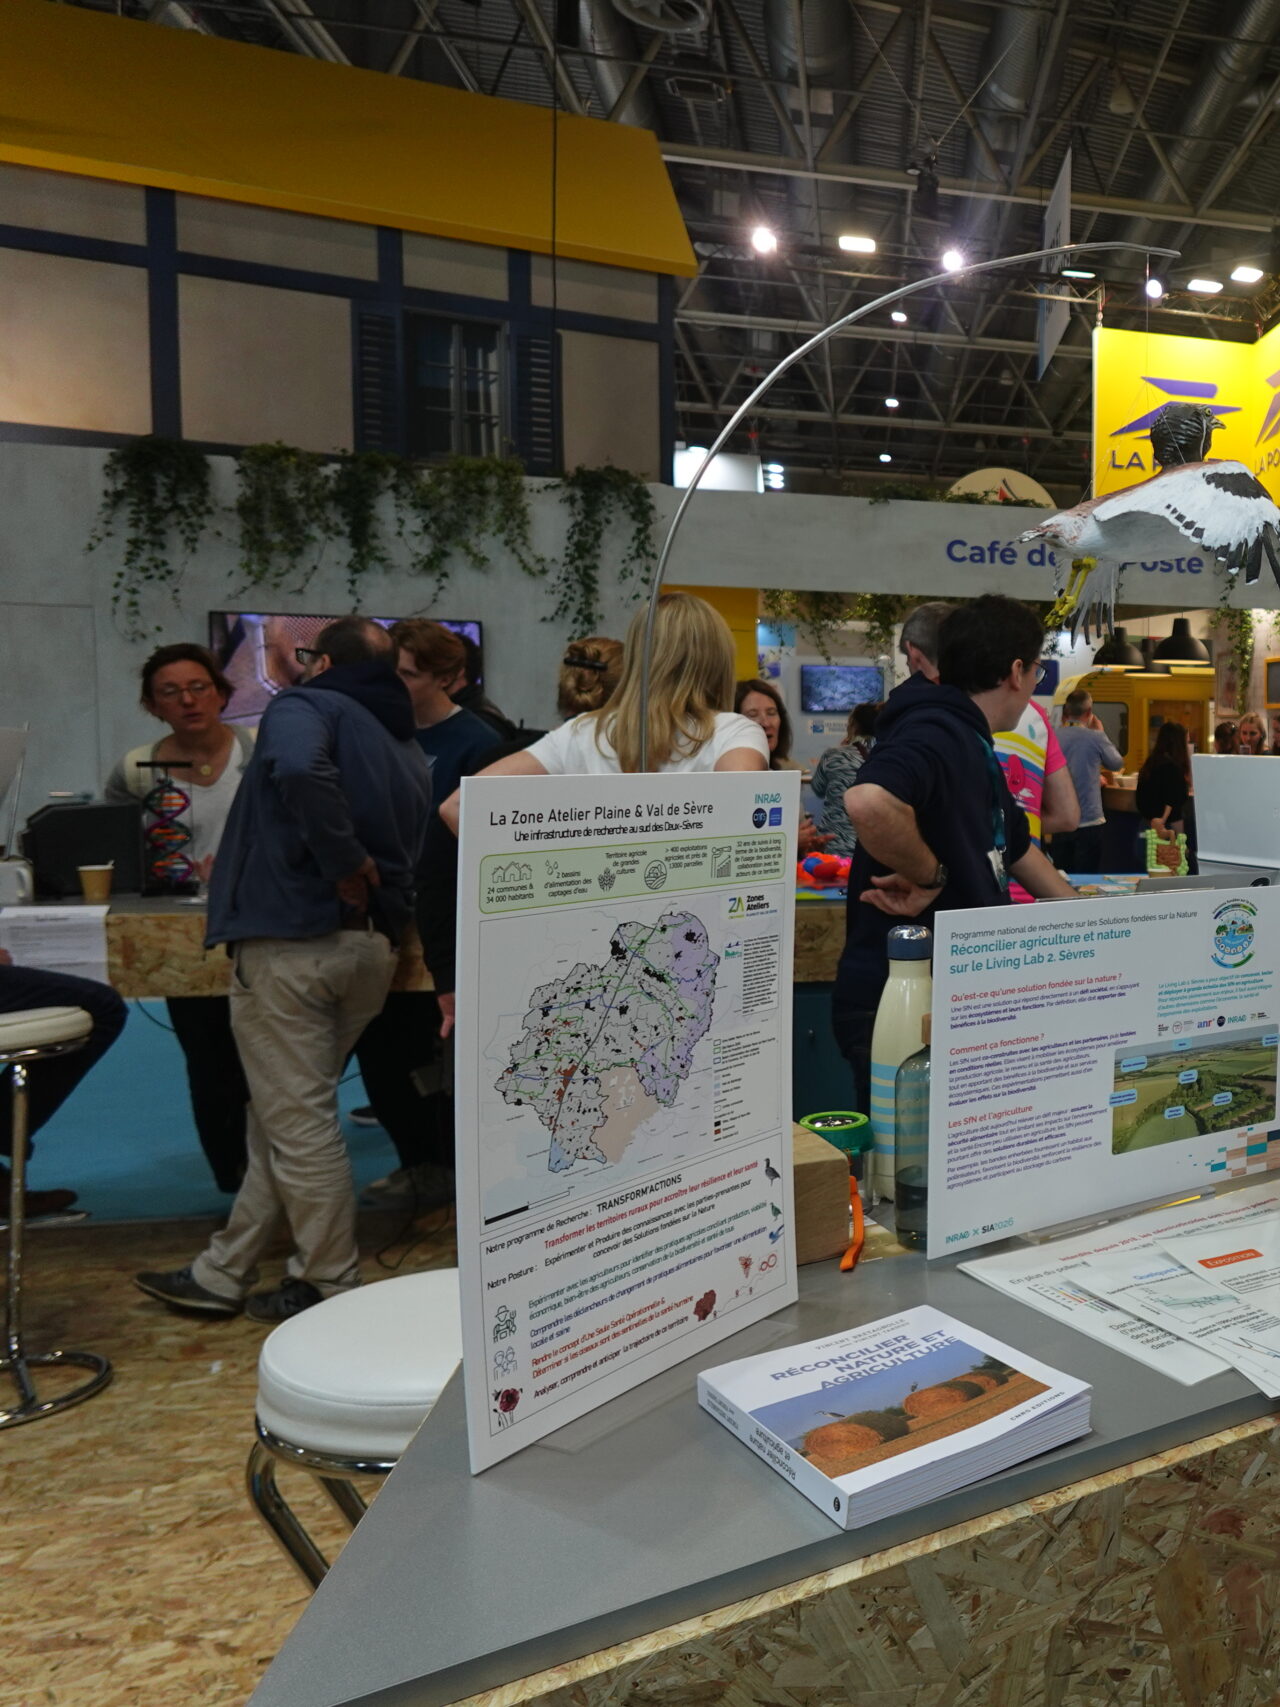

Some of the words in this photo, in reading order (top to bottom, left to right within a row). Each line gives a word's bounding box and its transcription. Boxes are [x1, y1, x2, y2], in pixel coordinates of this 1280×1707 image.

[1112, 450, 1145, 470] LA
[1254, 457, 1265, 474] LA
[947, 540, 1018, 565] Café
[1122, 556, 1204, 574] oste
[490, 812, 506, 826] La
[511, 810, 544, 824] Zone
[548, 808, 591, 822] Atelier
[595, 806, 631, 820] Plaine
[635, 804, 643, 817] &
[647, 803, 664, 817] Val
[667, 803, 680, 816] de
[684, 801, 713, 815] Sèvre
[515, 831, 529, 841] Une
[530, 828, 582, 840] infrastructure
[583, 827, 592, 837] de
[593, 824, 628, 836] recherche
[639, 823, 651, 833] sud
[652, 822, 663, 832] des
[664, 820, 703, 831] Deux-Sèvres
[488, 887, 495, 895] 24
[497, 885, 527, 894] communes
[529, 882, 533, 890] &
[508, 892, 534, 901] habitants
[746, 902, 769, 911] Ateliers
[951, 930, 995, 940] Programme
[997, 925, 1026, 936] national
[1028, 925, 1037, 933] de
[1039, 922, 1074, 932] recherche
[1099, 917, 1129, 926] Solutions
[1131, 914, 1157, 923] fondées
[1176, 911, 1198, 919] Nature
[951, 940, 1017, 956] Réconcilier
[1019, 934, 1081, 951] agriculture
[1083, 931, 1094, 942] et
[1097, 929, 1131, 940] nature
[950, 963, 968, 974] sur
[971, 960, 983, 971] le
[986, 956, 1020, 970] Living
[1023, 953, 1044, 965] Lab
[1047, 954, 1056, 963] 2.
[1059, 949, 1095, 961] Sèvres
[952, 991, 988, 1003] Qu'est-ce
[990, 987, 1015, 999] qu'une
[1017, 983, 1047, 993] solution
[1048, 979, 1073, 990] fondée
[1086, 977, 1093, 985] la
[1095, 975, 1117, 984] nature
[1198, 1020, 1212, 1028] anr
[950, 1042, 987, 1056] Comment
[989, 1042, 998, 1051] ça
[1000, 1036, 1039, 1048] fonctionne
[1040, 1033, 1044, 1041] ?
[948, 1119, 961, 1128] Les
[979, 1113, 986, 1122] et
[988, 1105, 1033, 1120] l'agriculture
[486, 1241, 505, 1254] Notre
[506, 1227, 545, 1249] programme
[546, 1223, 554, 1232] de
[556, 1210, 589, 1228] Recherche
[596, 1174, 682, 1214] TRANSFORM'ACTIONS
[982, 1217, 1014, 1234] SIA2026
[770, 1335, 911, 1380] RÉCONCILIER
[820, 1336, 958, 1390] AGRICULTURE
[836, 1341, 920, 1373] NATURE
[920, 1330, 947, 1342] ET
